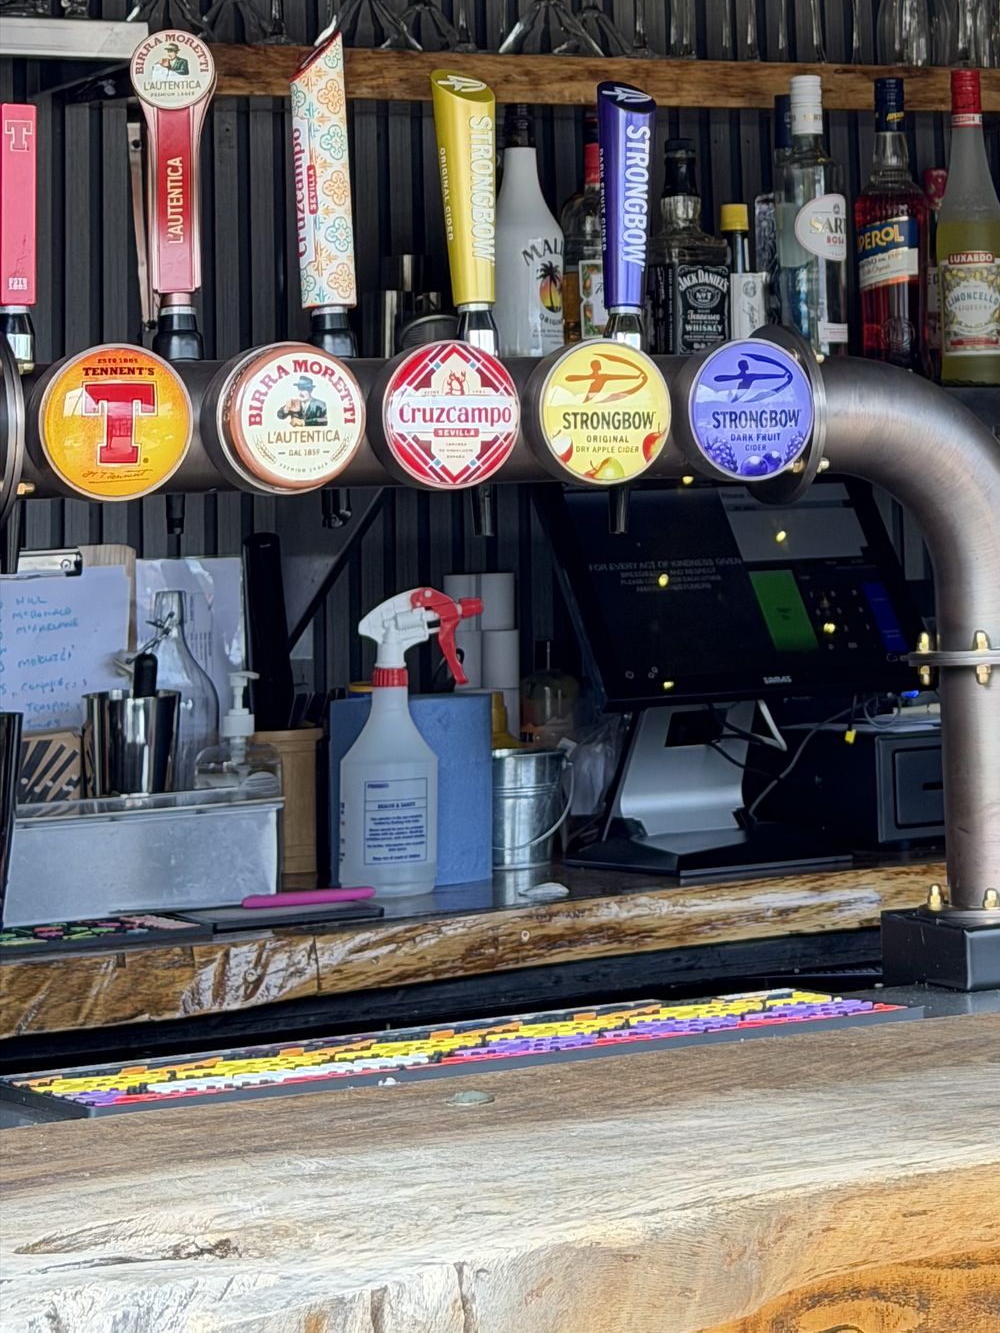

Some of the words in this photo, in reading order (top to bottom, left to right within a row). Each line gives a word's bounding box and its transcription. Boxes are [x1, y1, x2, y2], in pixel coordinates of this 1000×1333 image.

[136, 37, 162, 75] BIRRA
[165, 33, 209, 73] MORETTI
[143, 80, 201, 91] L'AUTENTICA
[4, 120, 32, 151] T
[308, 168, 317, 211] SEVILLA
[469, 115, 495, 263] STRONGBOW
[621, 124, 651, 268] STRONGBOW
[167, 157, 183, 244] L'AUTENTICA
[445, 205, 454, 242] CIDER
[857, 224, 905, 253] PEROL
[949, 253, 993, 263] LUXARDO
[678, 273, 698, 291] JACK
[697, 269, 729, 293] DANIEL'S
[946, 291, 999, 307] LIMONCELLO
[685, 324, 722, 332] WHISKEY
[82, 367, 155, 376] TENNENT'S
[249, 364, 290, 426] BIRRA
[292, 359, 356, 424] MORETTI
[82, 381, 158, 466] T
[398, 403, 512, 427] Cruzcampo
[562, 411, 656, 430] STRONGBOW
[711, 409, 801, 430] STRONGBOW
[267, 429, 341, 444] L'AUTENTICA
[586, 434, 629, 444] ORIGINAL
[730, 432, 754, 442] DARK
[756, 432, 781, 442] FRUIT
[304, 448, 320, 456] 1859
[575, 445, 591, 453] DRY
[592, 446, 616, 454] APPLE
[617, 445, 640, 453] CIDER
[745, 444, 767, 452] CIDER
